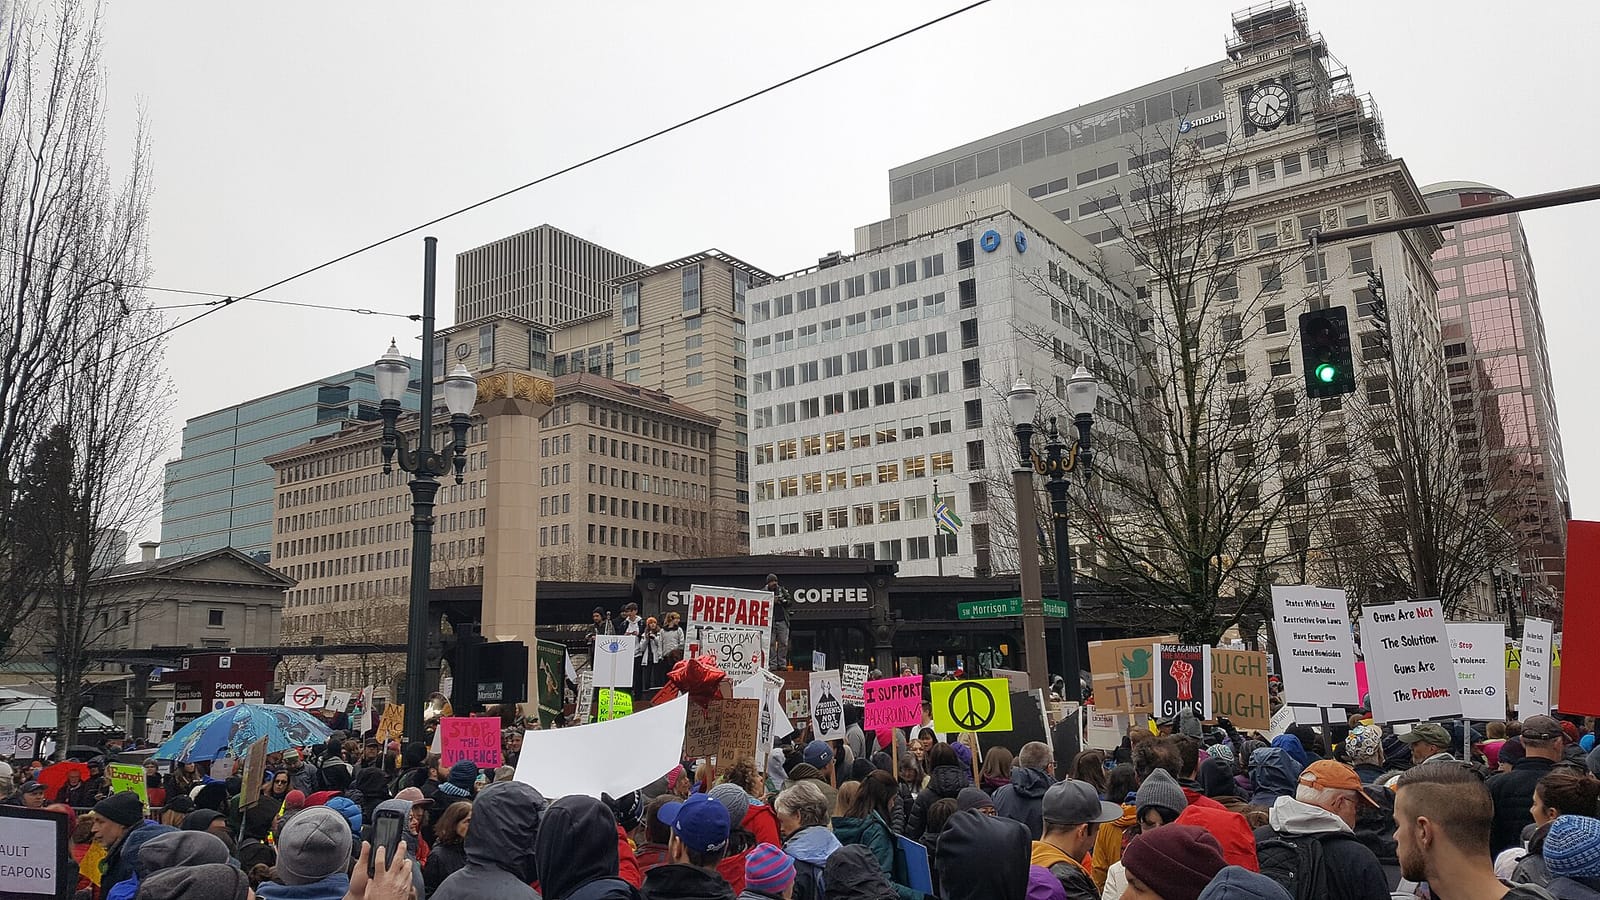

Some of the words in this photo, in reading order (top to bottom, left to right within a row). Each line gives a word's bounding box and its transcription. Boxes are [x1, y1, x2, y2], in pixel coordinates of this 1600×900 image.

[1191, 110, 1225, 127] smarsh
[794, 588, 868, 603] COFFEE
[692, 595, 769, 626] PREPARE
[972, 603, 1007, 615] Morrison
[1373, 612, 1395, 622] Guns
[1398, 609, 1414, 620] Are
[1416, 607, 1433, 618] Not
[1283, 616, 1315, 624] Restrictive
[708, 633, 736, 643] EVERY
[739, 632, 755, 643] DAY
[1381, 638, 1399, 649] The
[1401, 634, 1439, 647] Solution.
[721, 644, 743, 662] 96
[1302, 665, 1313, 673] And
[1314, 666, 1335, 674] Suicides
[1394, 664, 1415, 674] Guns
[1418, 661, 1435, 672] Are
[1213, 676, 1223, 688] is
[866, 688, 875, 703] I
[879, 683, 921, 701] SUPPORT
[1393, 690, 1410, 702] The
[1412, 687, 1450, 700] Problem.
[816, 707, 841, 716] STUDENTS
[1164, 700, 1202, 716] GUNS
[449, 722, 489, 738] STOP
[821, 721, 838, 729] GUNS
[460, 738, 479, 747] THE
[448, 750, 497, 764] VIOLENCE
